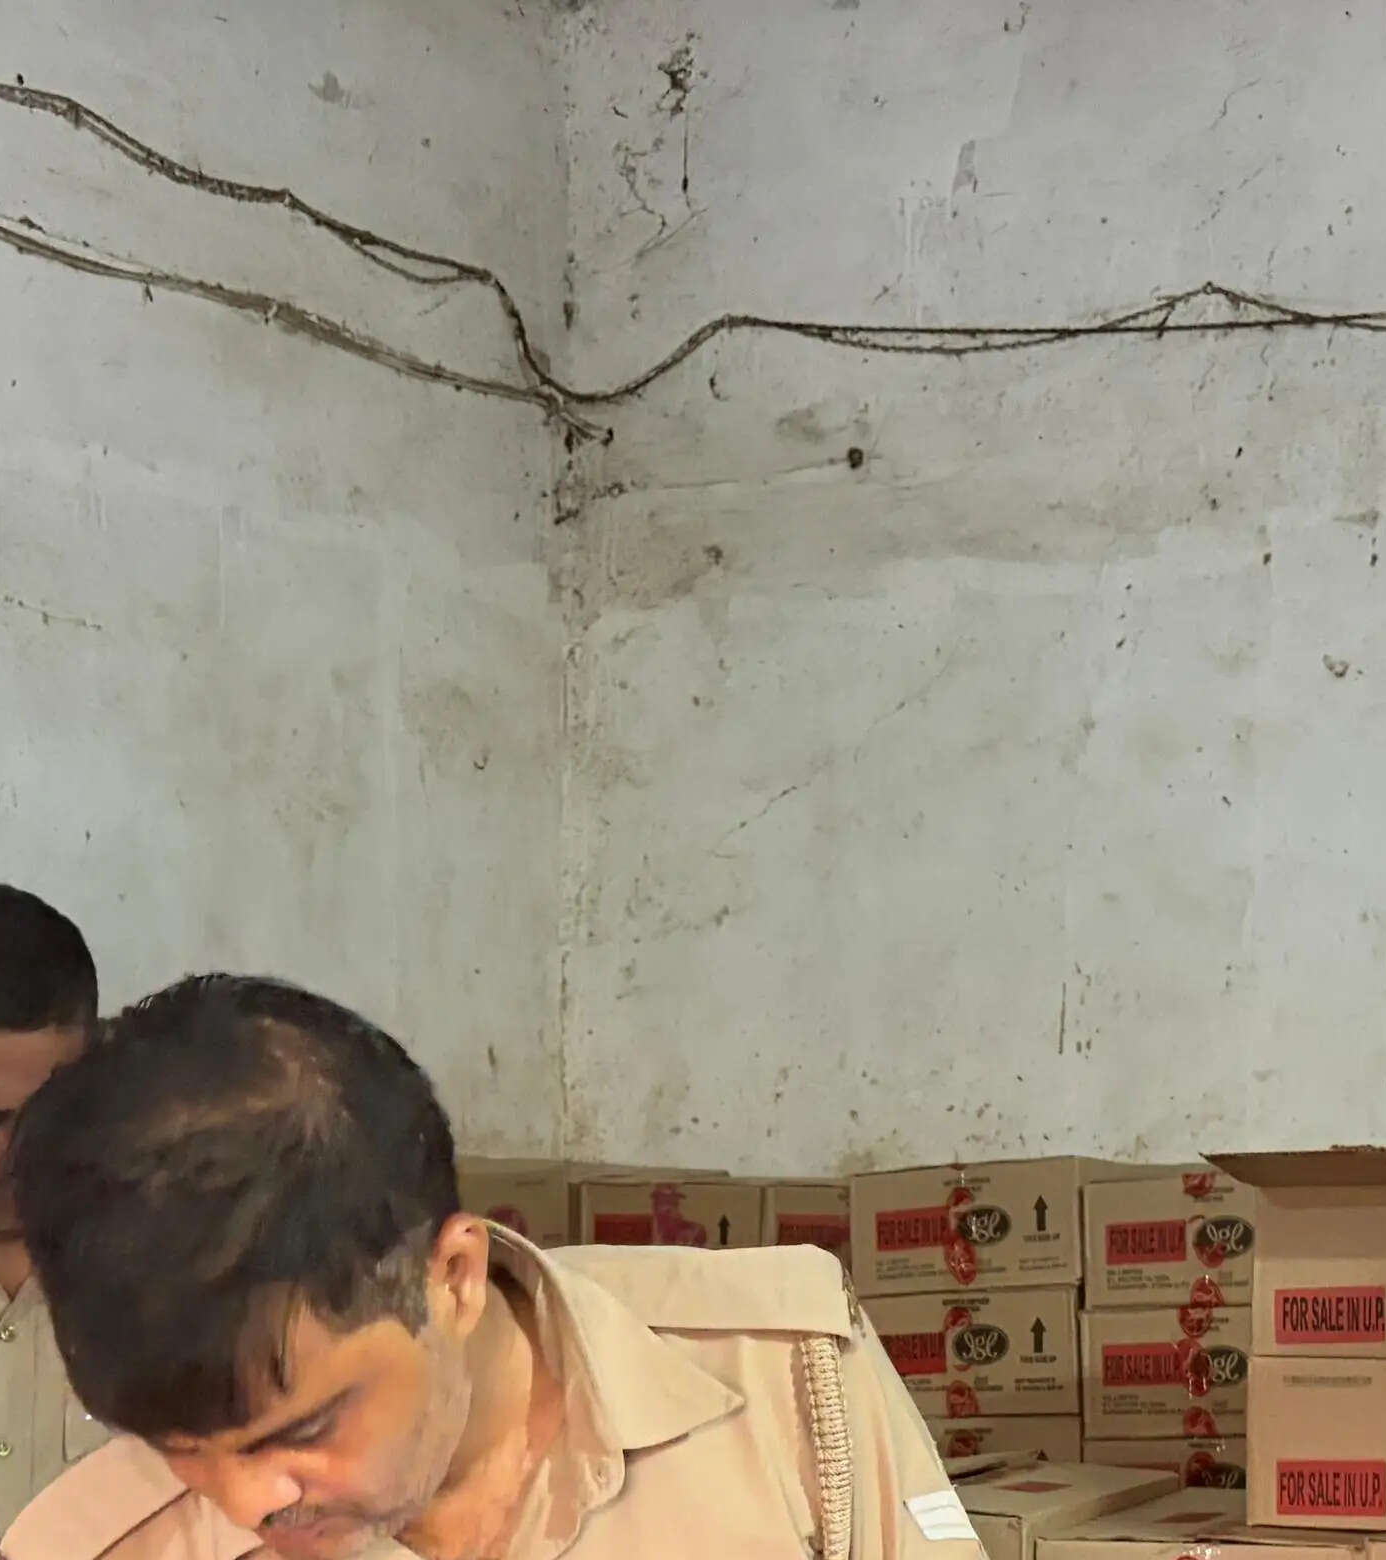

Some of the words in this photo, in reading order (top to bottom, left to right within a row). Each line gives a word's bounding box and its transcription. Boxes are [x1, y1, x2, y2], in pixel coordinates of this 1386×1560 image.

[1283, 1297, 1310, 1331] FOR
[1312, 1297, 1344, 1331] SALE
[1346, 1298, 1359, 1331] IN
[1279, 1472, 1305, 1506] FOR
[1307, 1472, 1342, 1507] SALE
[1345, 1473, 1357, 1508] IN
